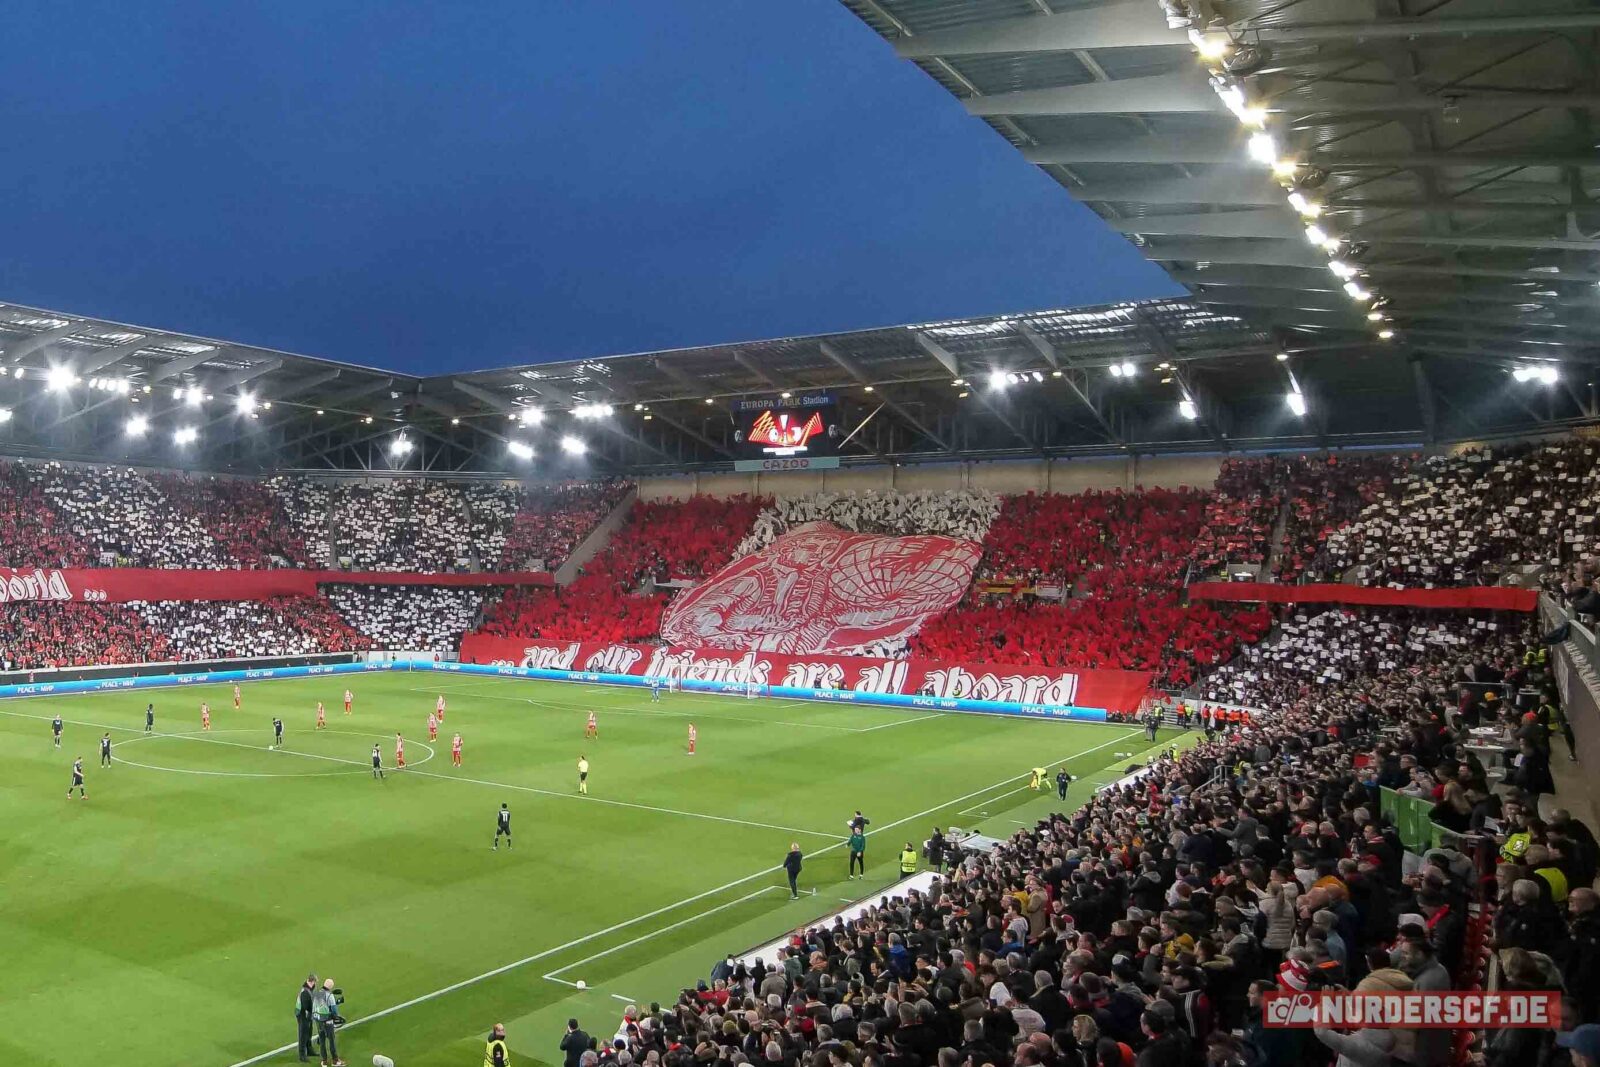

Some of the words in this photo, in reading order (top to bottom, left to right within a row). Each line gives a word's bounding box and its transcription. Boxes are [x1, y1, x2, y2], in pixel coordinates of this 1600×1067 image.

[741, 400, 774, 409] EUROPA
[778, 398, 801, 407] PARK
[763, 458, 809, 469] CAZOO
[521, 643, 580, 669] and
[585, 644, 642, 674] our
[645, 646, 772, 683] friends
[782, 662, 844, 689] are
[855, 660, 909, 694] all
[921, 667, 1078, 706] aboard
[1022, 705, 1045, 714] PEACE
